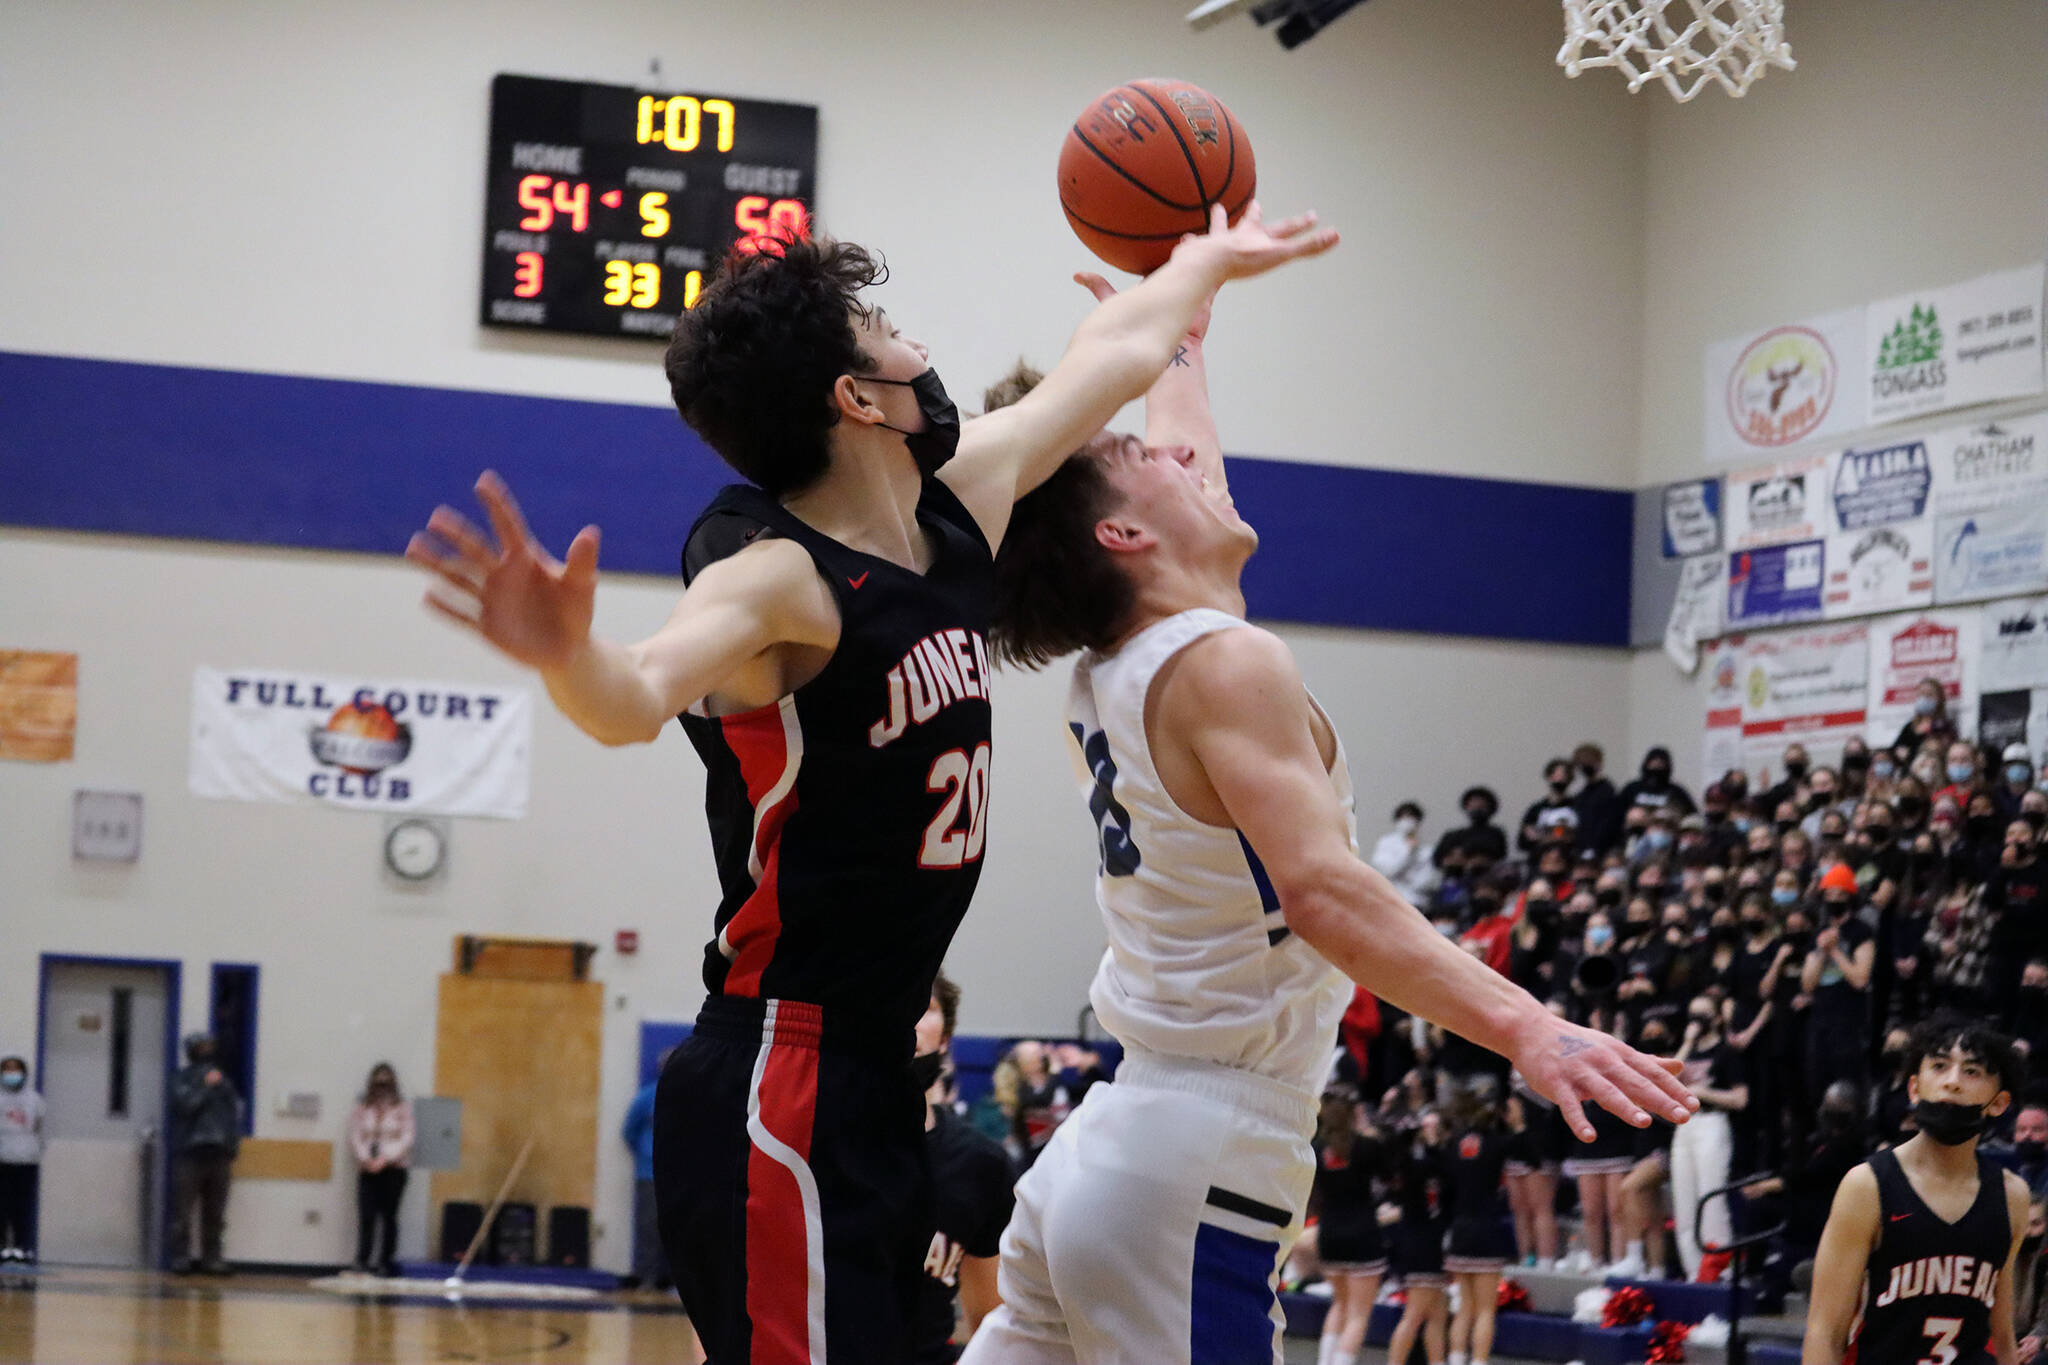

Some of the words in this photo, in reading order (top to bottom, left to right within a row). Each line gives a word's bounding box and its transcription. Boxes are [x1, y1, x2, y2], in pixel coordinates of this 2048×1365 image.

[636, 95, 735, 152] 1:07
[512, 143, 583, 175] HOME
[724, 162, 800, 194] GUEST
[518, 174, 590, 232] 54
[639, 191, 671, 238] 5
[513, 251, 544, 298] 3
[603, 260, 661, 308] 33
[227, 679, 333, 708] FULL
[353, 689, 499, 719] COURT
[868, 627, 991, 748] JUNEA
[309, 774, 411, 799] CLUB
[917, 741, 991, 870] 20
[1916, 1316, 1964, 1365] 3
